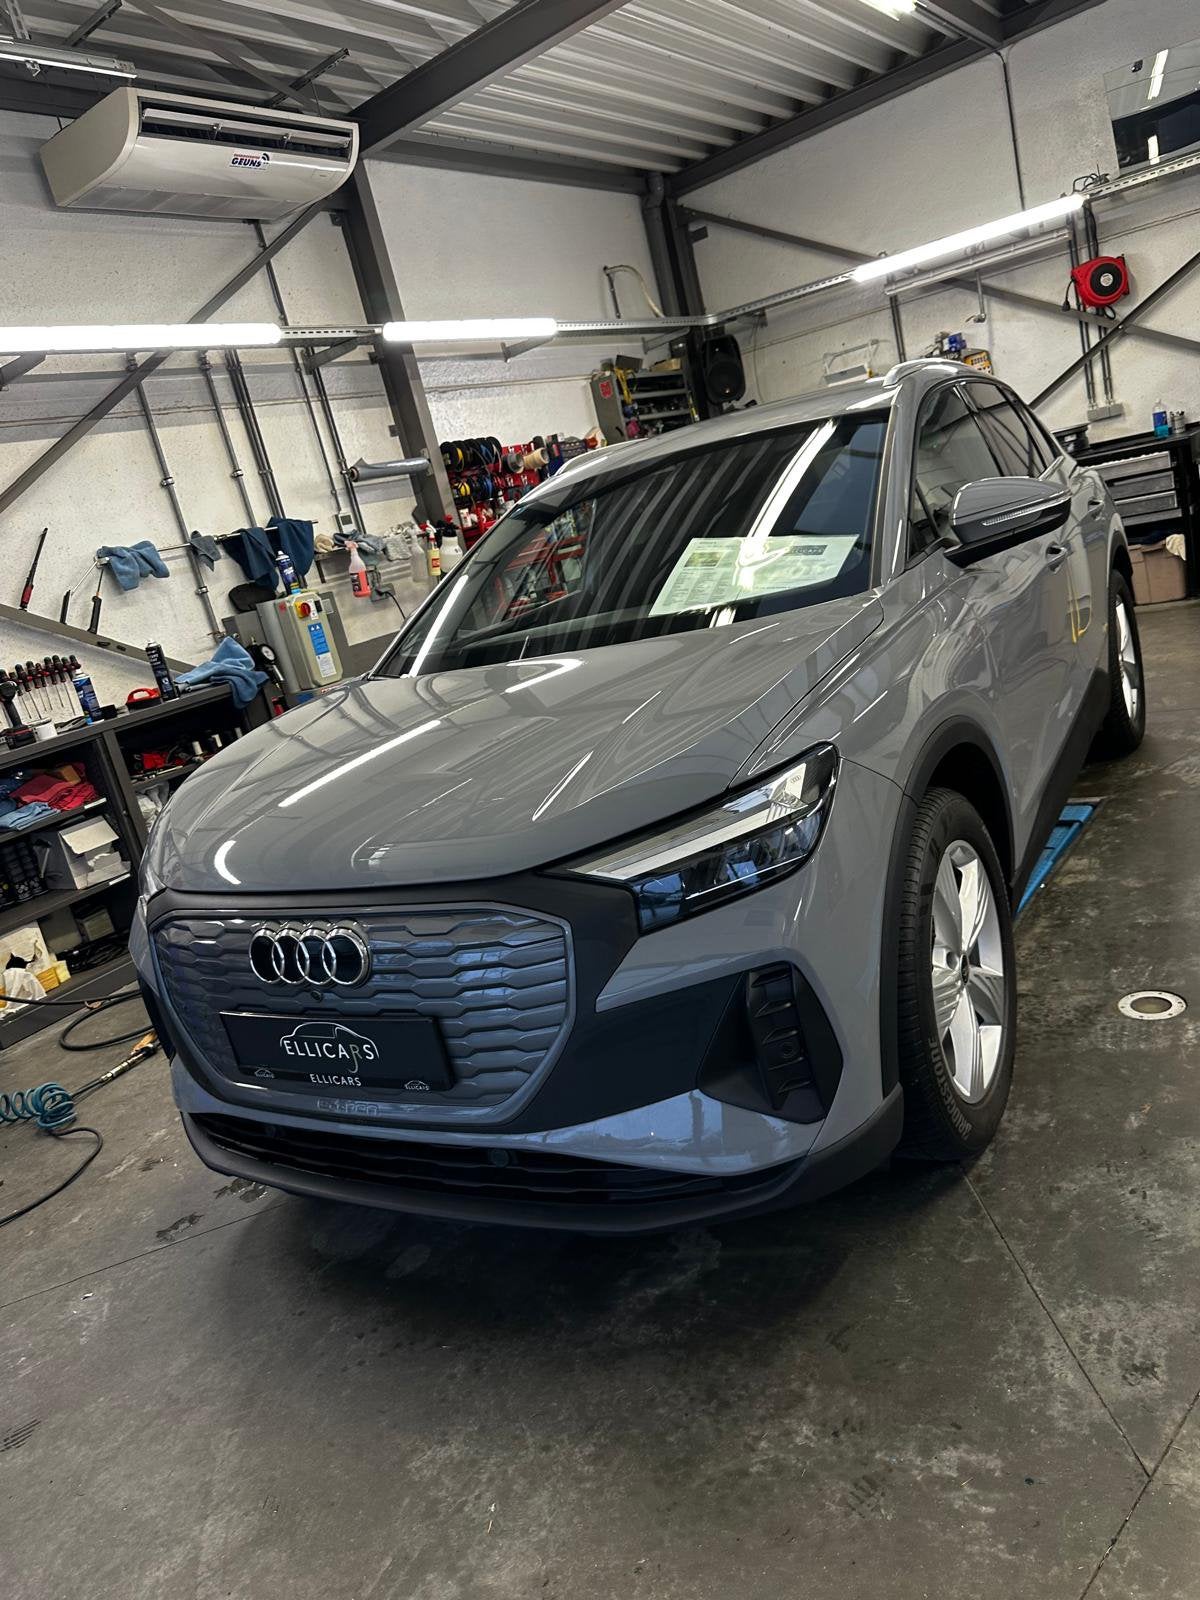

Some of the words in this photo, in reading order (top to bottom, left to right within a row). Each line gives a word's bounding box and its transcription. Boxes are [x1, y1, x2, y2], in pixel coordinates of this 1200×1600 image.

[231, 157, 262, 167] GEUNS
[283, 1040, 375, 1074] ELLICARS
[309, 1073, 362, 1087] ELLICARS
